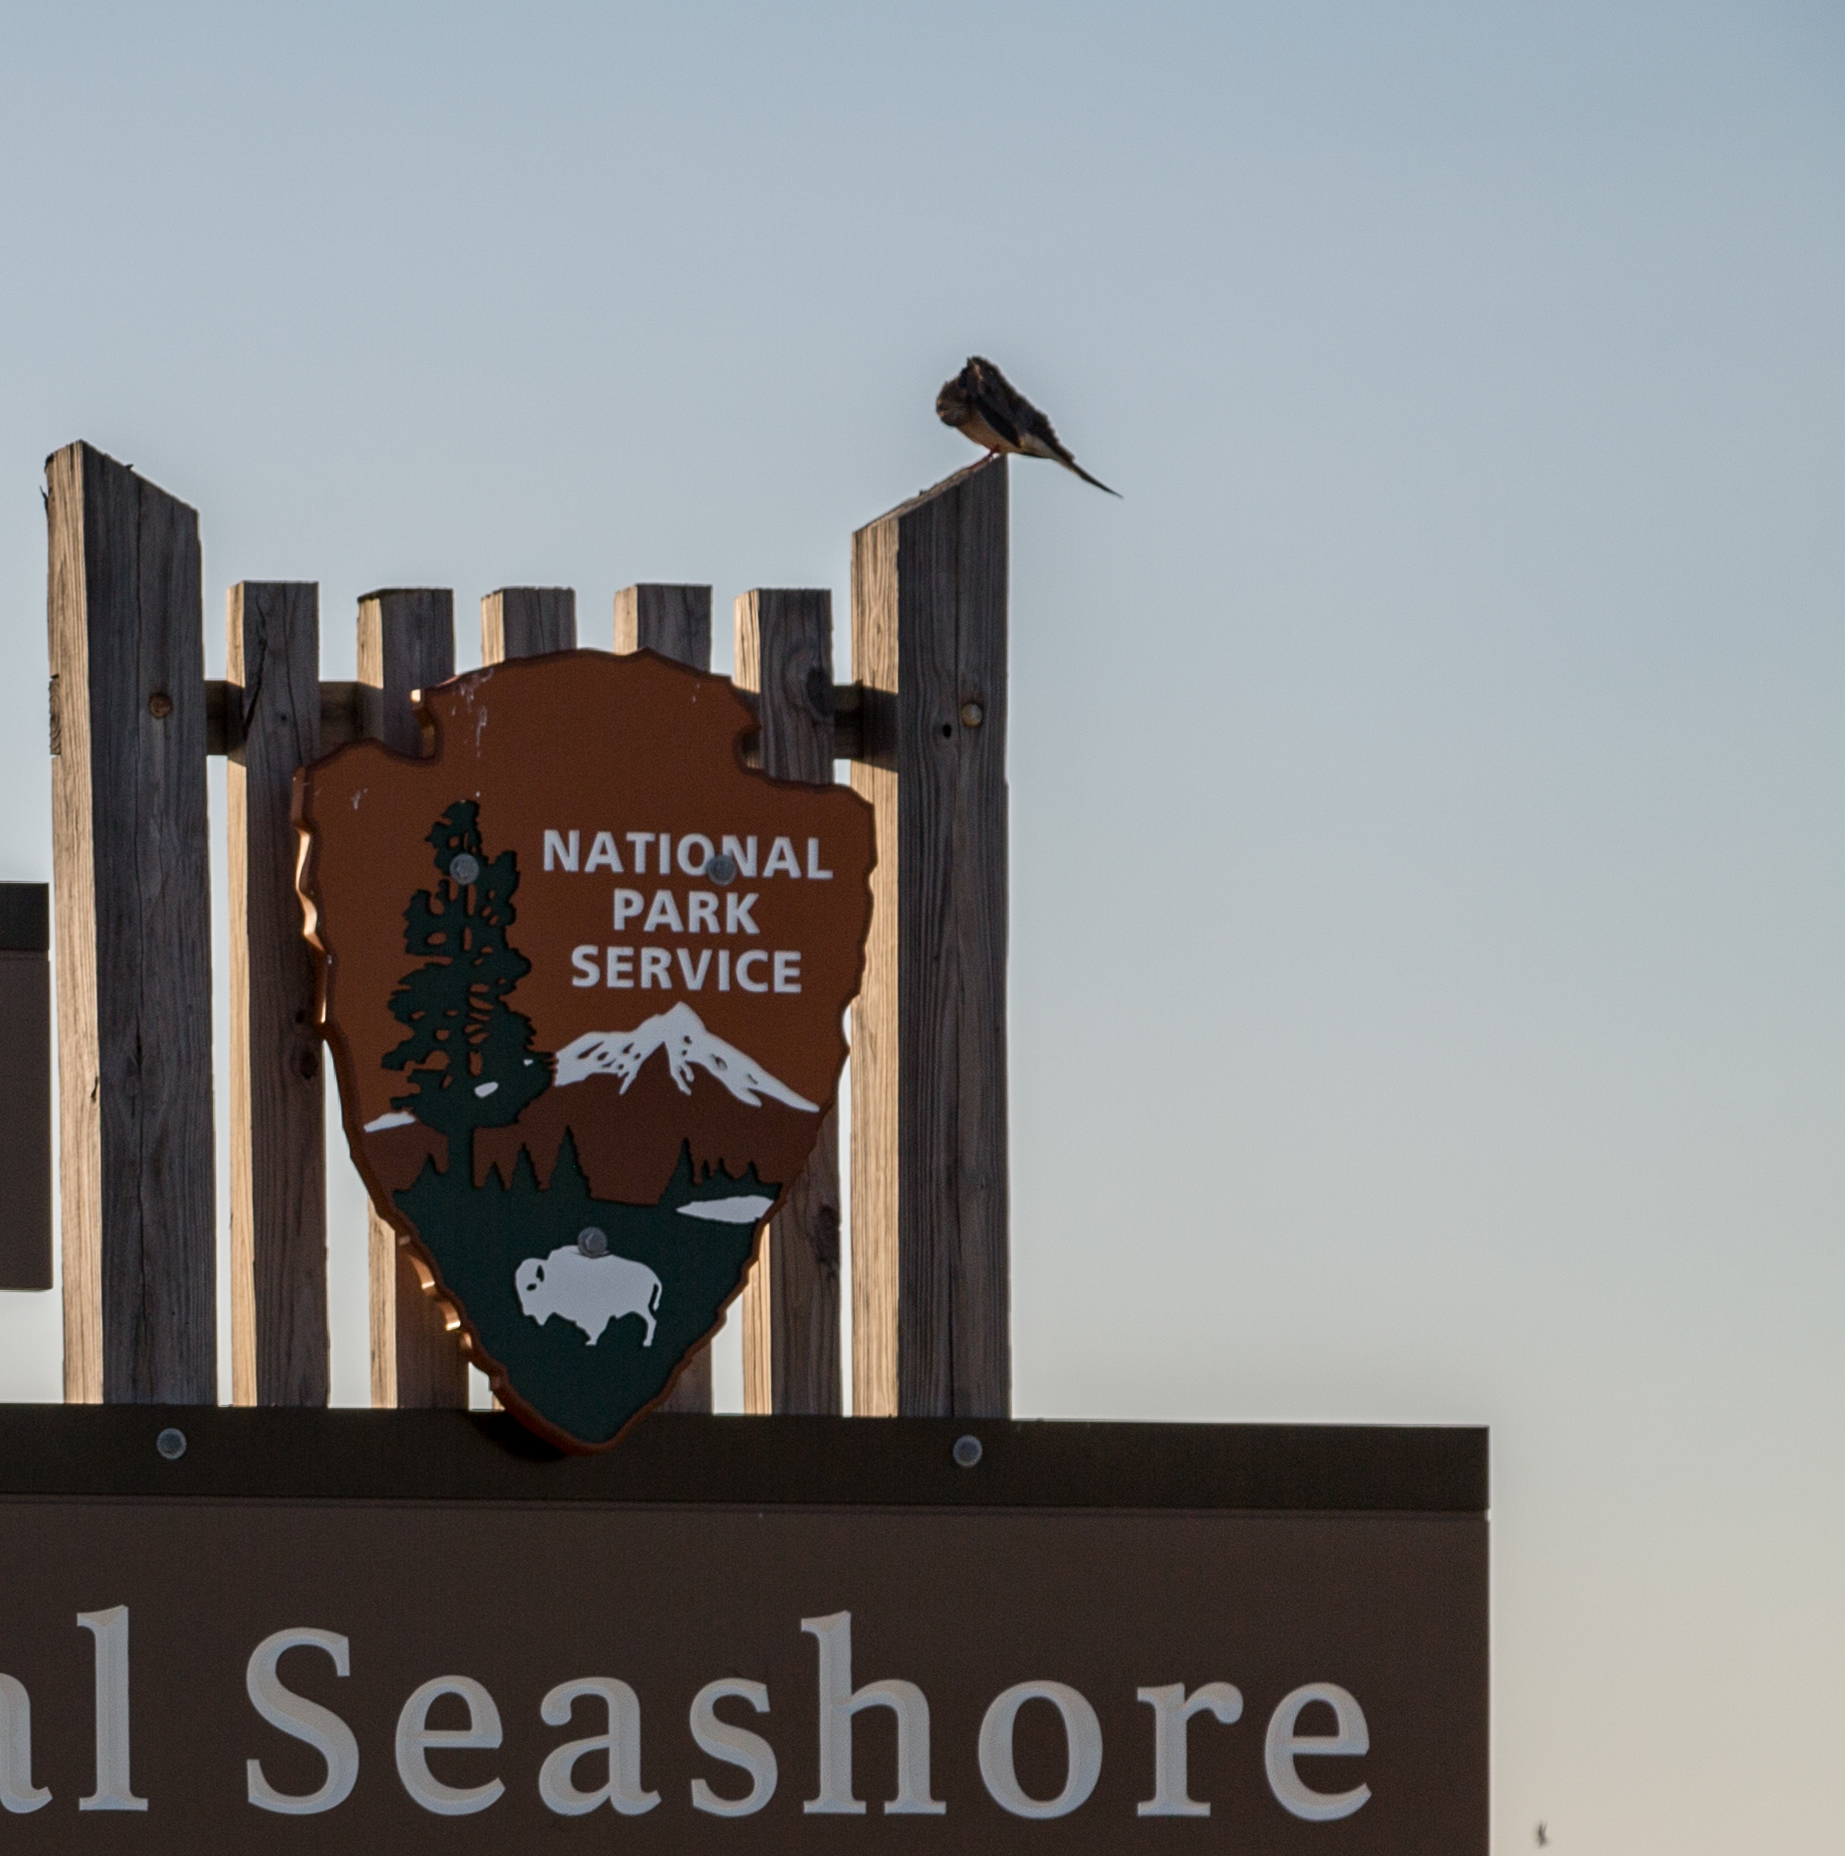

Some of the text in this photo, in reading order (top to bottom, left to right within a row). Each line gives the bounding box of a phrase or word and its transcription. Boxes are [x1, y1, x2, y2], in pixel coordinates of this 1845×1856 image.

[544, 830, 833, 881] NATIONAL
[614, 889, 759, 934] PARK
[571, 945, 801, 993] SERVICE
[246, 1611, 1371, 1821] Seashore
